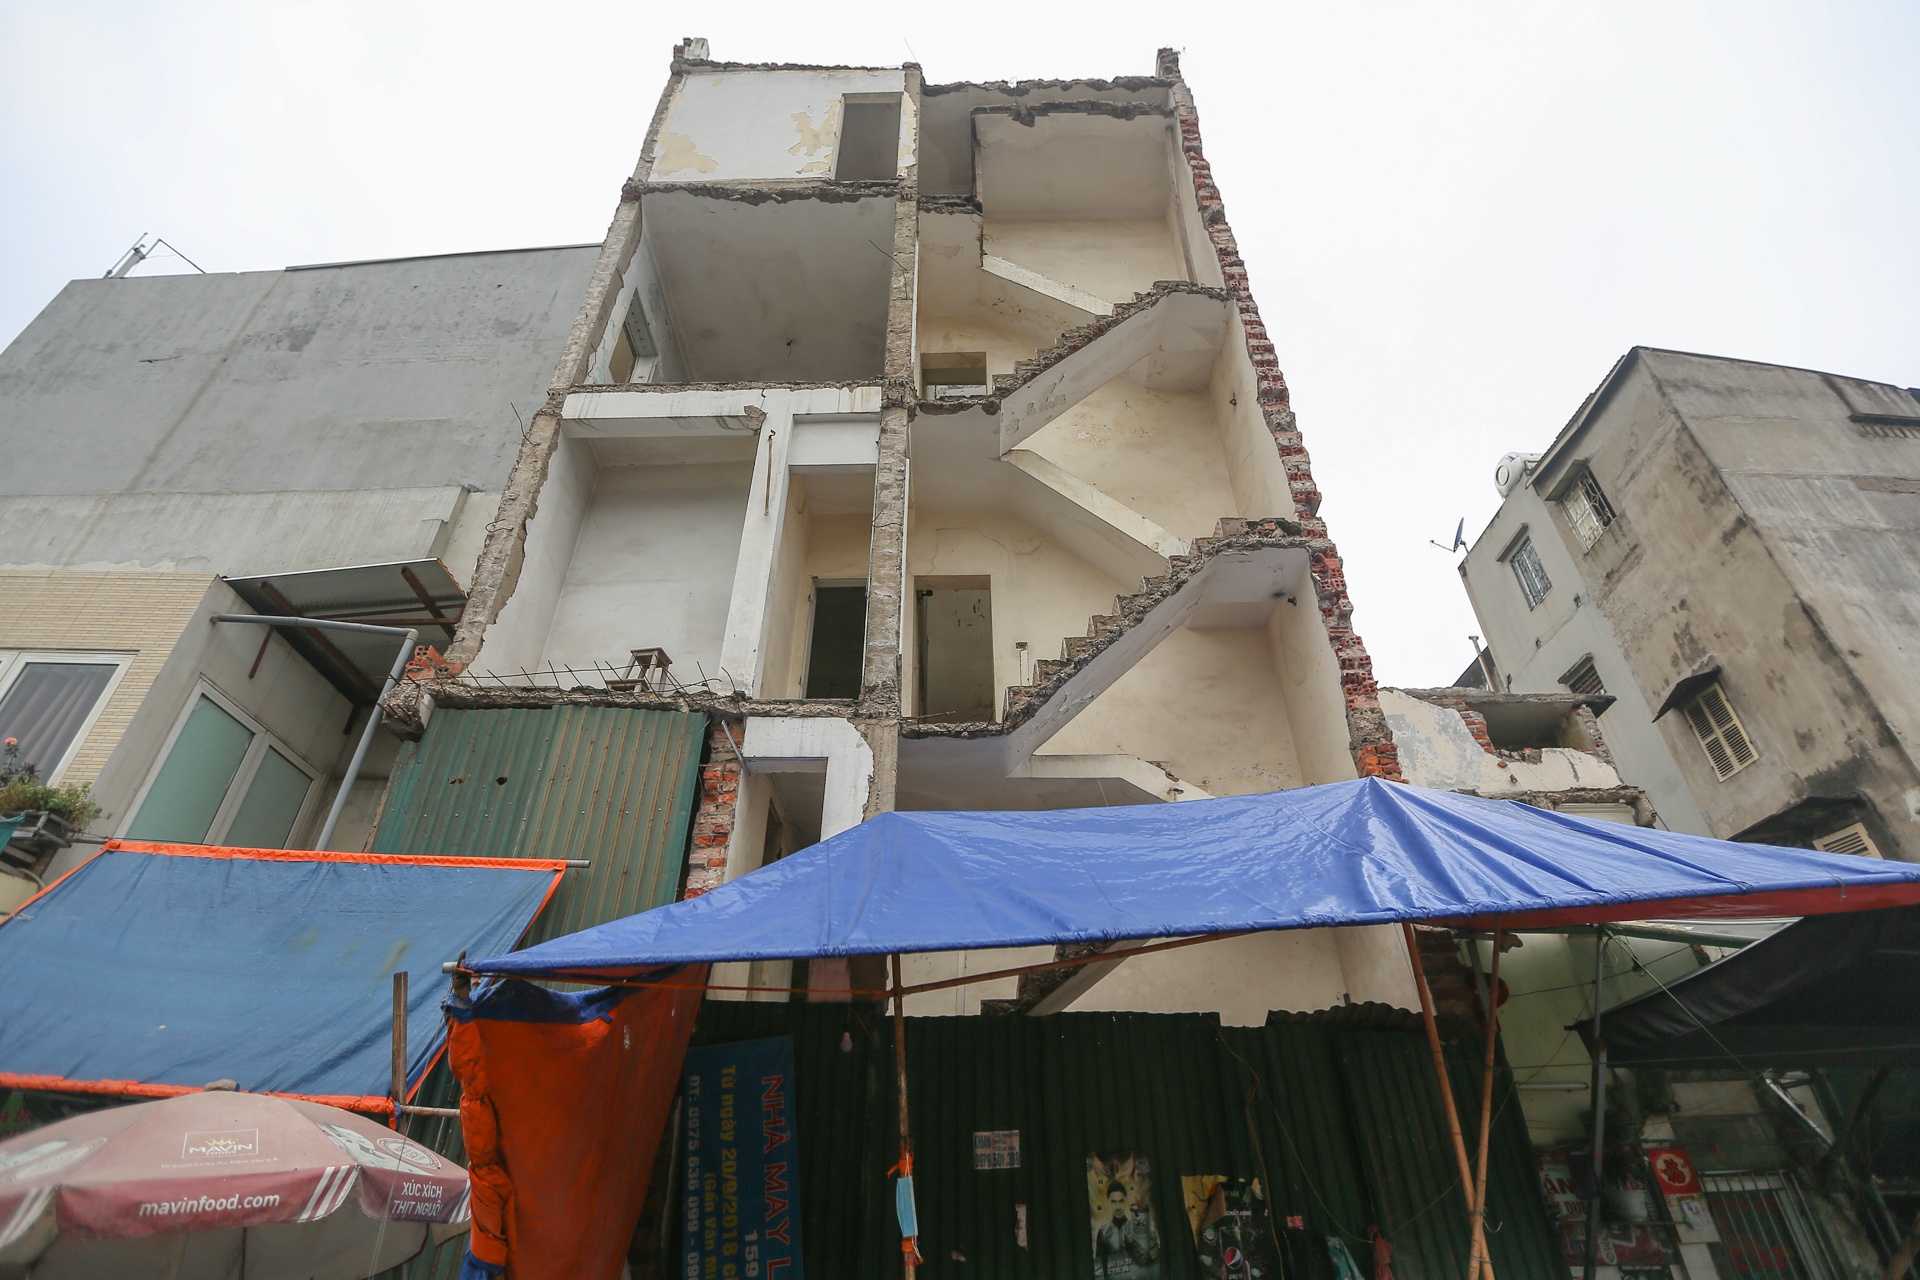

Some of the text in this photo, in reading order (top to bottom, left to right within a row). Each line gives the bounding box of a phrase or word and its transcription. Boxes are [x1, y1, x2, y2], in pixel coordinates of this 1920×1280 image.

[688, 1107, 700, 1150] 0975
[720, 1094, 737, 1142] ngày
[761, 1075, 790, 1153] NHÀ
[189, 1143, 253, 1154] MAVIN
[401, 1179, 443, 1199] XÚC XÍCH
[687, 1156, 700, 1190] 636
[138, 1193, 280, 1217] mavinfood.com
[391, 1200, 416, 1218] THỊT
[687, 1196, 700, 1232] 099
[721, 1148, 739, 1257] 20/9/2018
[764, 1162, 790, 1246] MAY
[744, 1229, 759, 1278] 159
